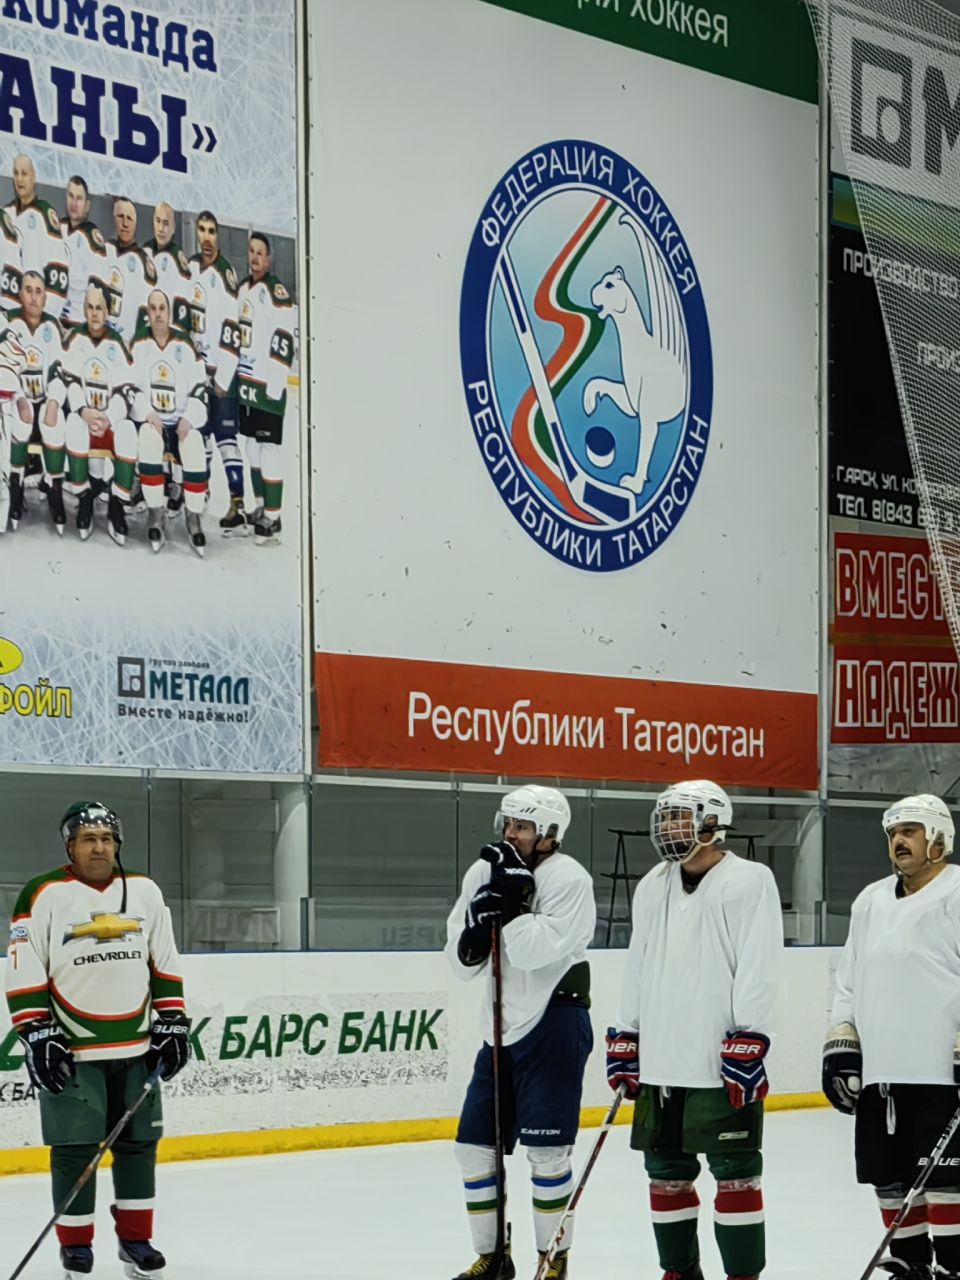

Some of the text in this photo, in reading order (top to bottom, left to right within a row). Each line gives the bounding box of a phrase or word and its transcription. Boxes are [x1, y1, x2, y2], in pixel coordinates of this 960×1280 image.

[630, 0, 728, 47] хоккея
[481, 146, 697, 294] ФЕДЕРАЦИЯ ХОККЕЯ
[49, 269, 68, 290] 99
[271, 335, 290, 357] 45
[468, 380, 708, 567] РЕСПУБЛИКИ ТАТАРСТАН
[837, 493, 867, 518] ТЕЛ.
[150, 670, 249, 705] МЕТАЛЛ
[118, 703, 248, 723] Вместе надёжно!
[408, 691, 764, 764] Республики Татарстан
[73, 950, 142, 966] CHEVROLET
[28, 1027, 63, 1043] BAU
[153, 1024, 189, 1034] AUER
[219, 1013, 329, 1060] БАРС
[338, 1009, 444, 1054] БАНК
[606, 1042, 638, 1053] UER
[720, 1042, 761, 1054] UER
[521, 1127, 561, 1136] EASTON
